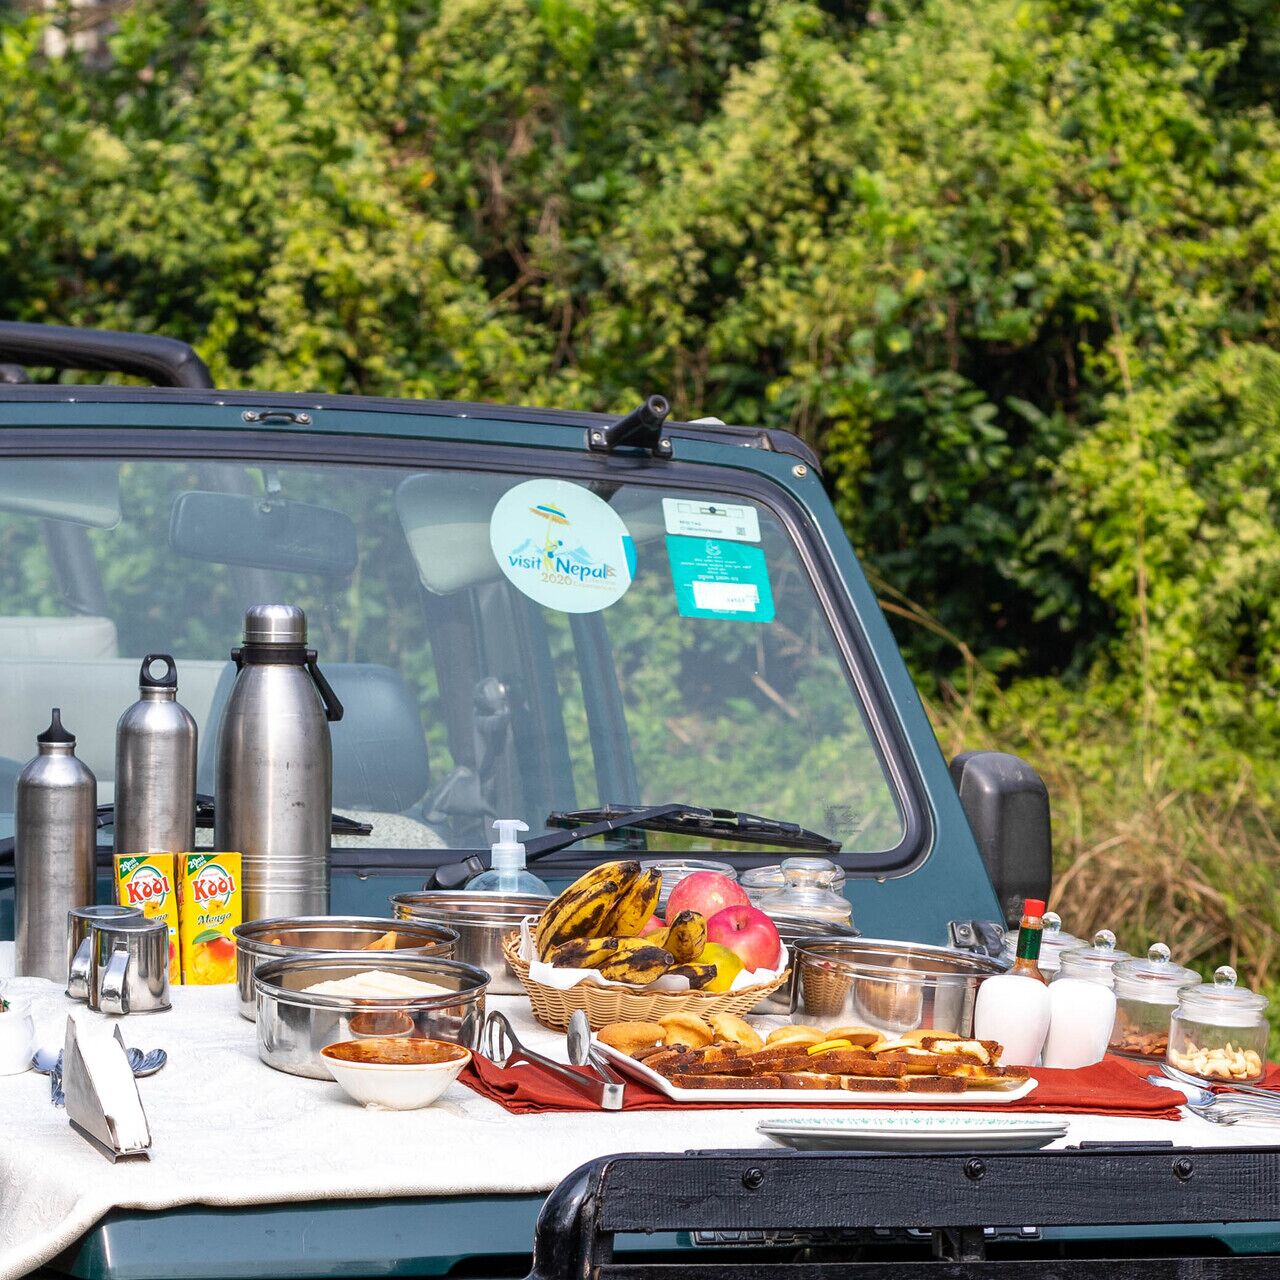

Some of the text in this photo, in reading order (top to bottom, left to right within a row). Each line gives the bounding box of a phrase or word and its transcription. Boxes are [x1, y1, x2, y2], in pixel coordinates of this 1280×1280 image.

[556, 557, 607, 581] Nepal
[541, 572, 573, 586] 2020
[197, 912, 232, 926] Mango
